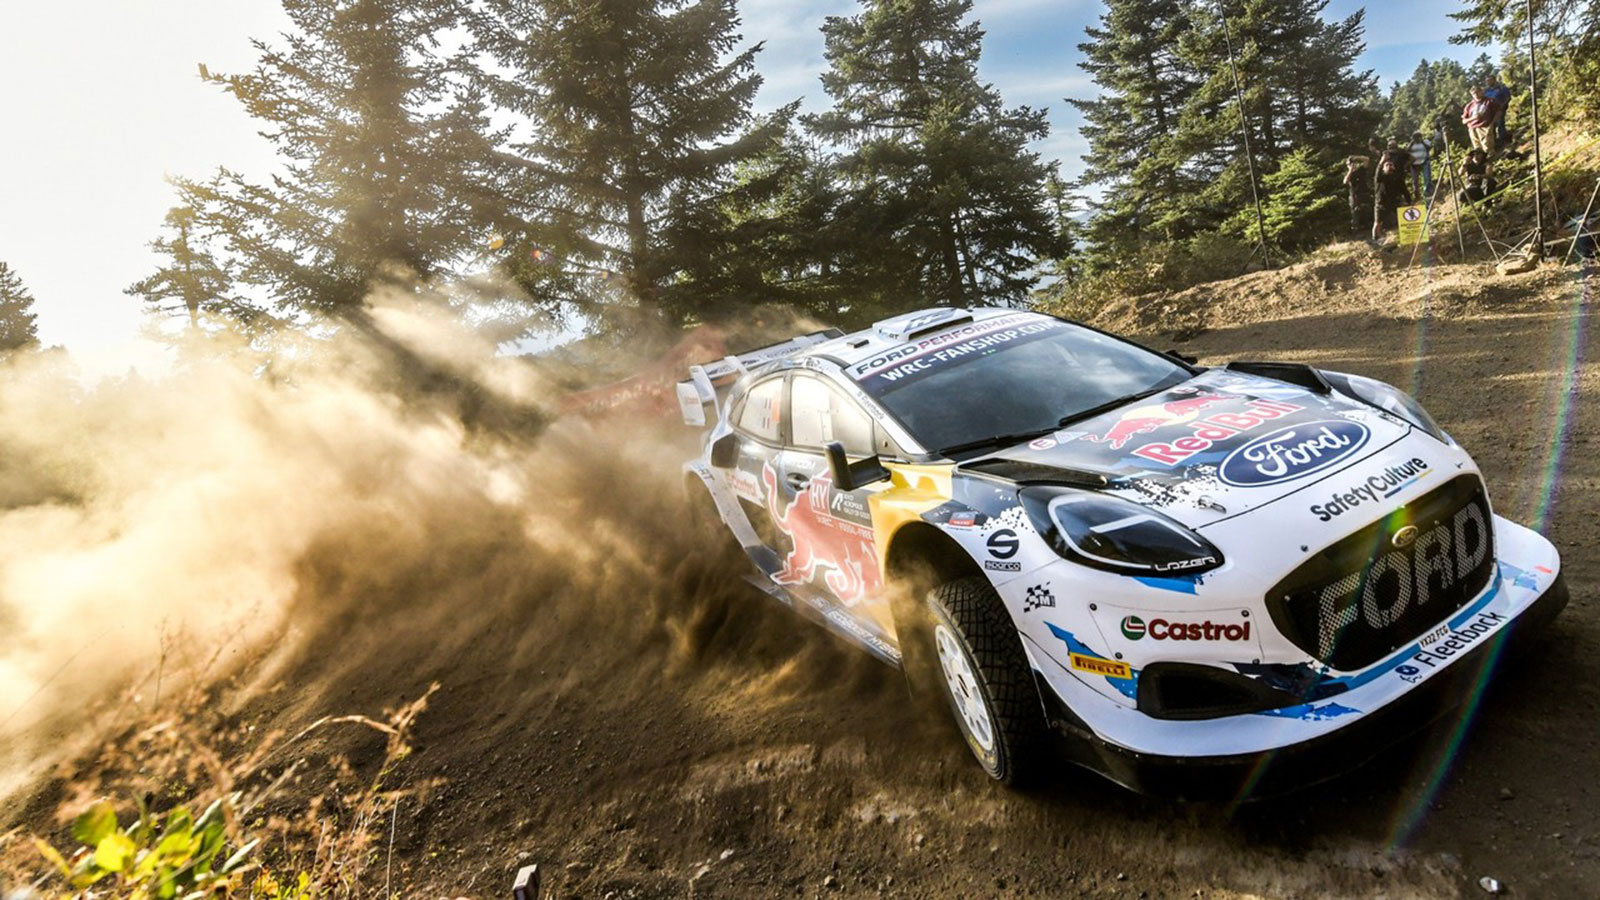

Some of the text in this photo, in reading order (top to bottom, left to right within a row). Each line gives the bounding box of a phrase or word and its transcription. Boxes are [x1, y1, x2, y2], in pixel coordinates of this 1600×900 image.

[857, 346, 918, 375] FORD
[880, 320, 1061, 382] WRC-FANSHOP.COM
[1243, 426, 1350, 477] Ford
[1310, 457, 1428, 522] SafetyCulture
[1318, 502, 1488, 660] FORD
[1148, 618, 1250, 641] Castrol
[1414, 611, 1508, 667] Fleetback
[1074, 655, 1126, 676] PIRELLI
